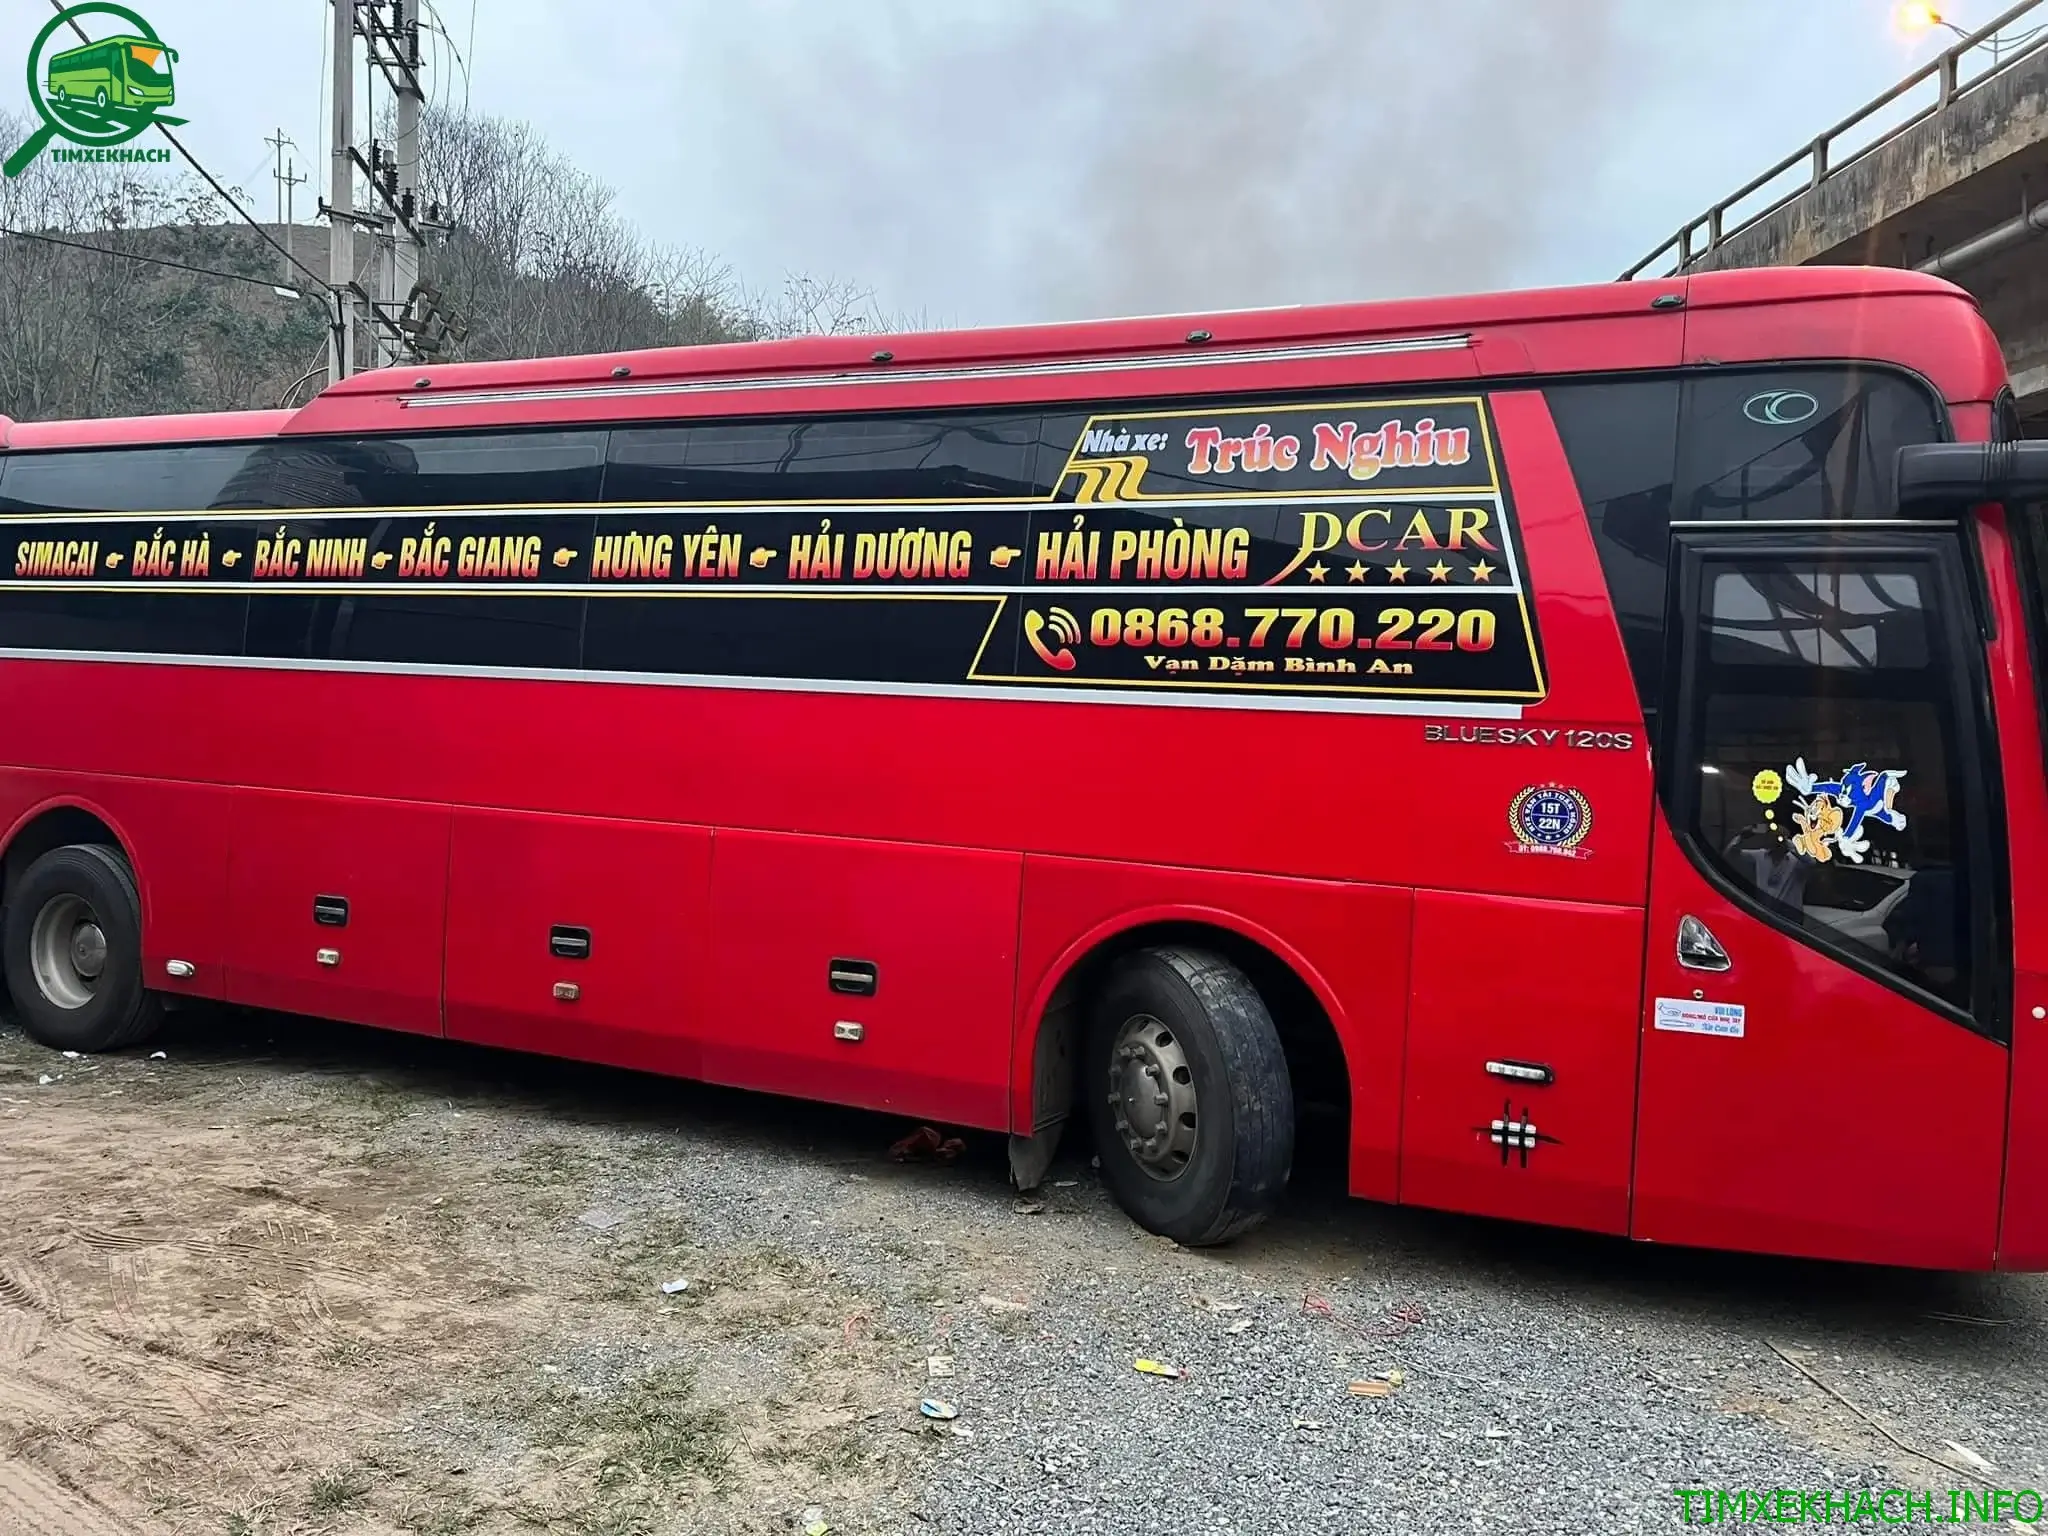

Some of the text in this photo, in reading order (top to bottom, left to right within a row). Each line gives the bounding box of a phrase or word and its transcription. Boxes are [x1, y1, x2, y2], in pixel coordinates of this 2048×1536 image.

[1082, 428, 1169, 453] Nhà xe:
[1185, 418, 1471, 479] Trúc Nghiu
[15, 514, 1250, 580] SIMACAI BẮC HÀ BẮC NINH BẮC GIANG HƯNG YÊN HẢI DƯƠNG HẢI PHÒNG
[1268, 507, 1499, 568] DCAR
[1090, 607, 1496, 651] 0868.770.220
[1144, 655, 1414, 677] Vạn Dặm Bình An
[1424, 725, 1633, 749] BLUESKY 120S
[1541, 802, 1561, 814] 15T
[1538, 818, 1561, 830] 22N
